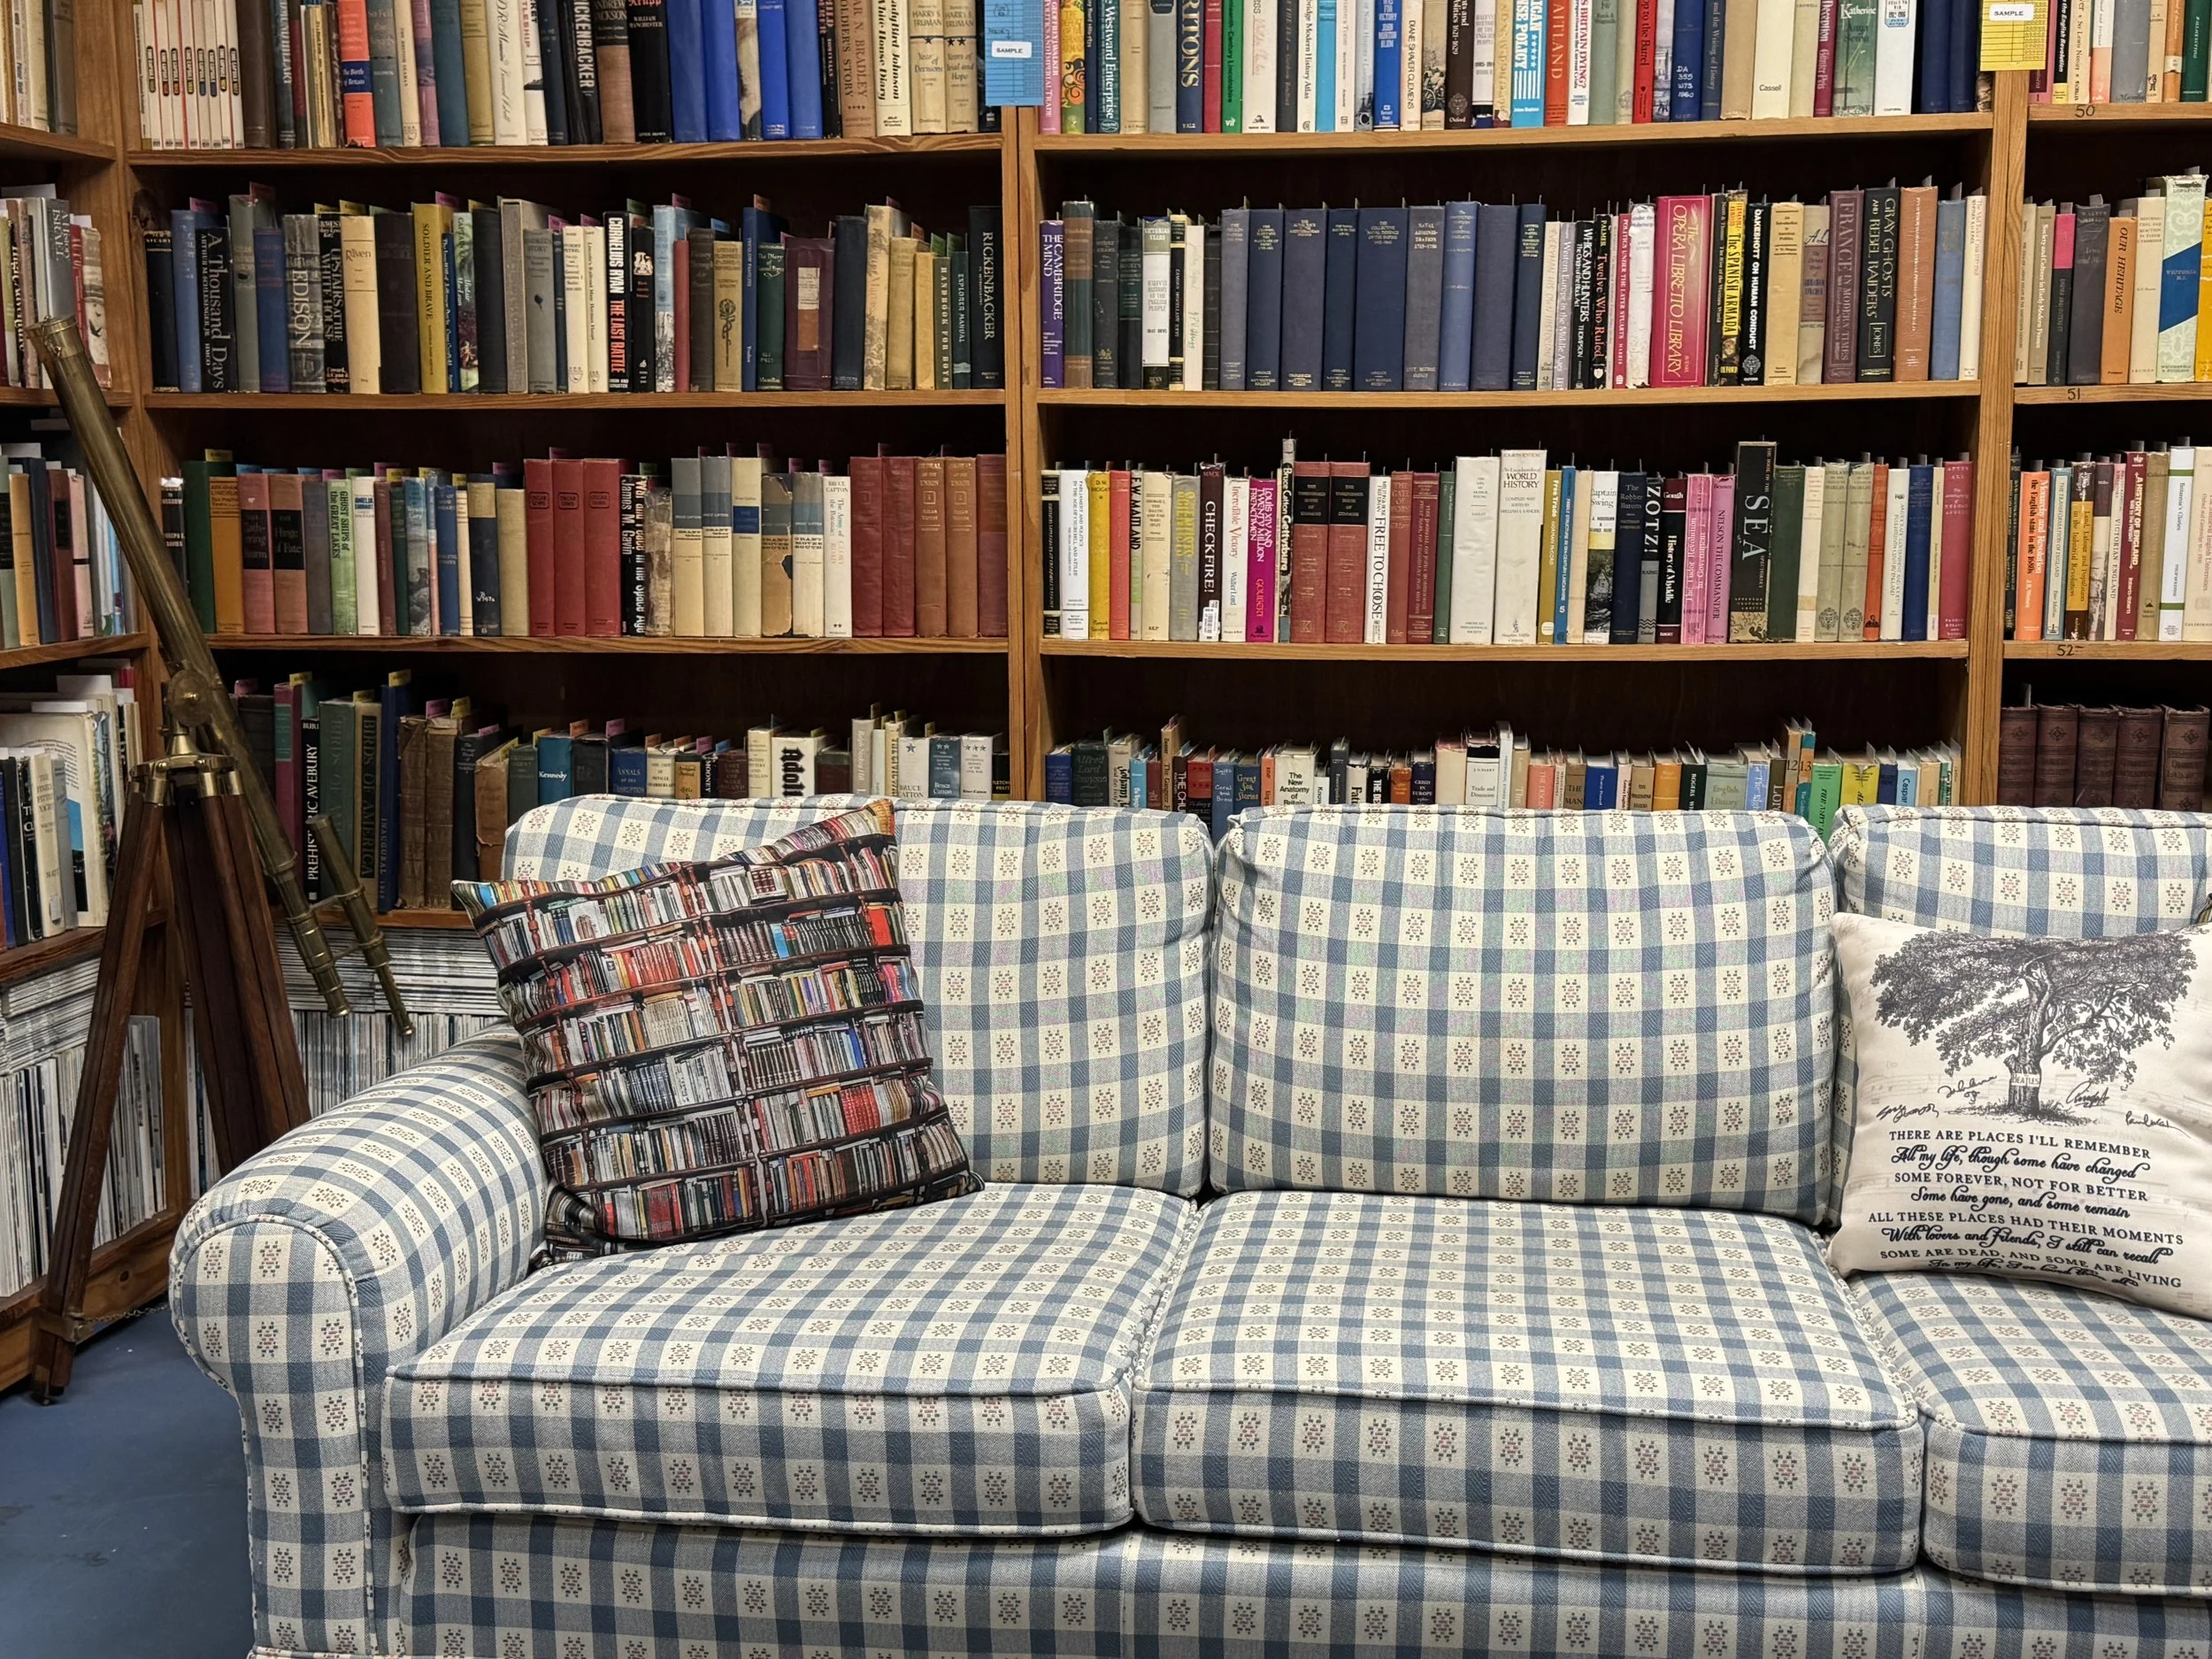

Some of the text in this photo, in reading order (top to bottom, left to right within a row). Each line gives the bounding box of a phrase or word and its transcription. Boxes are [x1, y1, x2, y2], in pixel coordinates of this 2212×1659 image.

[1181, 0, 1200, 87] RITONS
[1515, 24, 1527, 69] POLICY
[1579, 4, 1588, 50] BRITAIN
[1103, 6, 1116, 119] Westward Enterprise
[1302, 53, 1311, 80] History
[2075, 104, 2094, 118] 50
[422, 223, 431, 265] SOLDIER
[1868, 219, 1880, 257] REBEL
[1881, 197, 1896, 298] GRAY GHOSTS
[1043, 243, 1053, 277] MIND
[1595, 253, 1608, 293] Twelve
[1748, 209, 1762, 349] OAKESHOTT ON HUMAN CONDUCT
[1838, 202, 1854, 360] FRANCE IN MODERN TIMES
[2114, 227, 2128, 314] OUR HERITAGE
[322, 253, 334, 342] WHITE HOUSE
[608, 217, 626, 373] CORNELIUS RYAN THE LAST BATTLE
[940, 266, 949, 325] HANDBOOK
[982, 232, 995, 340] RICKENBACKER
[1054, 243, 1063, 320] CAMBRIDGE
[1668, 204, 1687, 378] OPERA LIBRETTO LIBRARY
[1724, 233, 1741, 333] The SPANISH ARMADA
[1866, 261, 1879, 319] RAIDERS
[207, 234, 230, 388] A Thousand Days
[292, 269, 311, 349] EDISON
[425, 289, 434, 320] BRAVE
[1594, 296, 1606, 323] Who
[1594, 326, 1605, 357] Ruled
[1872, 326, 1882, 354] JONES
[2067, 388, 2081, 401] 51
[330, 504, 339, 530] GREAT
[340, 491, 349, 517] GHOST
[621, 480, 634, 555] James M. Gavin
[1175, 491, 1195, 557] SCIENTISTS
[1232, 486, 1241, 525] Incredible
[1644, 486, 1661, 553] ZOTZ!
[331, 533, 340, 558] LAKES
[341, 518, 349, 541] SHIPS
[1204, 501, 1217, 593] CHECKFIRE!
[1229, 526, 1242, 558] Victory
[1741, 495, 1770, 560] SEA
[2112, 518, 2121, 561] VICTORIAN
[1371, 517, 1386, 619] FREE TO CHOOSE
[1712, 565, 1723, 619] COMMANDER
[2056, 644, 2074, 657] 52
[306, 744, 318, 799] AVEBURY
[539, 771, 567, 782] Kennedy
[1787, 760, 1798, 771] 12
[1800, 761, 1812, 771] 13
[361, 719, 375, 876] BIRDS OF AMERICA
[1901, 778, 1910, 803] Caspar
[1890, 1131, 2151, 1158] THERE ARE PLACES I'LL REMEMBER
[1892, 1144, 2151, 1184] All my life, though some have changed
[1894, 1172, 2148, 1201] SOME FOREVER, NOT FOR BETTER
[1911, 1185, 2131, 1218] Some have gone, and some remain
[1869, 1212, 2184, 1245] ALL THESE PLACES HAD THEIR MOMENTS
[1881, 1225, 2173, 1263] With lovers and friends, I still can recall
[1880, 1249, 1920, 1258] SOME
[1957, 1248, 2004, 1258] DEAD,
[2009, 1252, 2040, 1262] AND
[2046, 1256, 2088, 1267] SOME
[2094, 1263, 2124, 1273] ARE
[2128, 1270, 2181, 1287] LIVING
